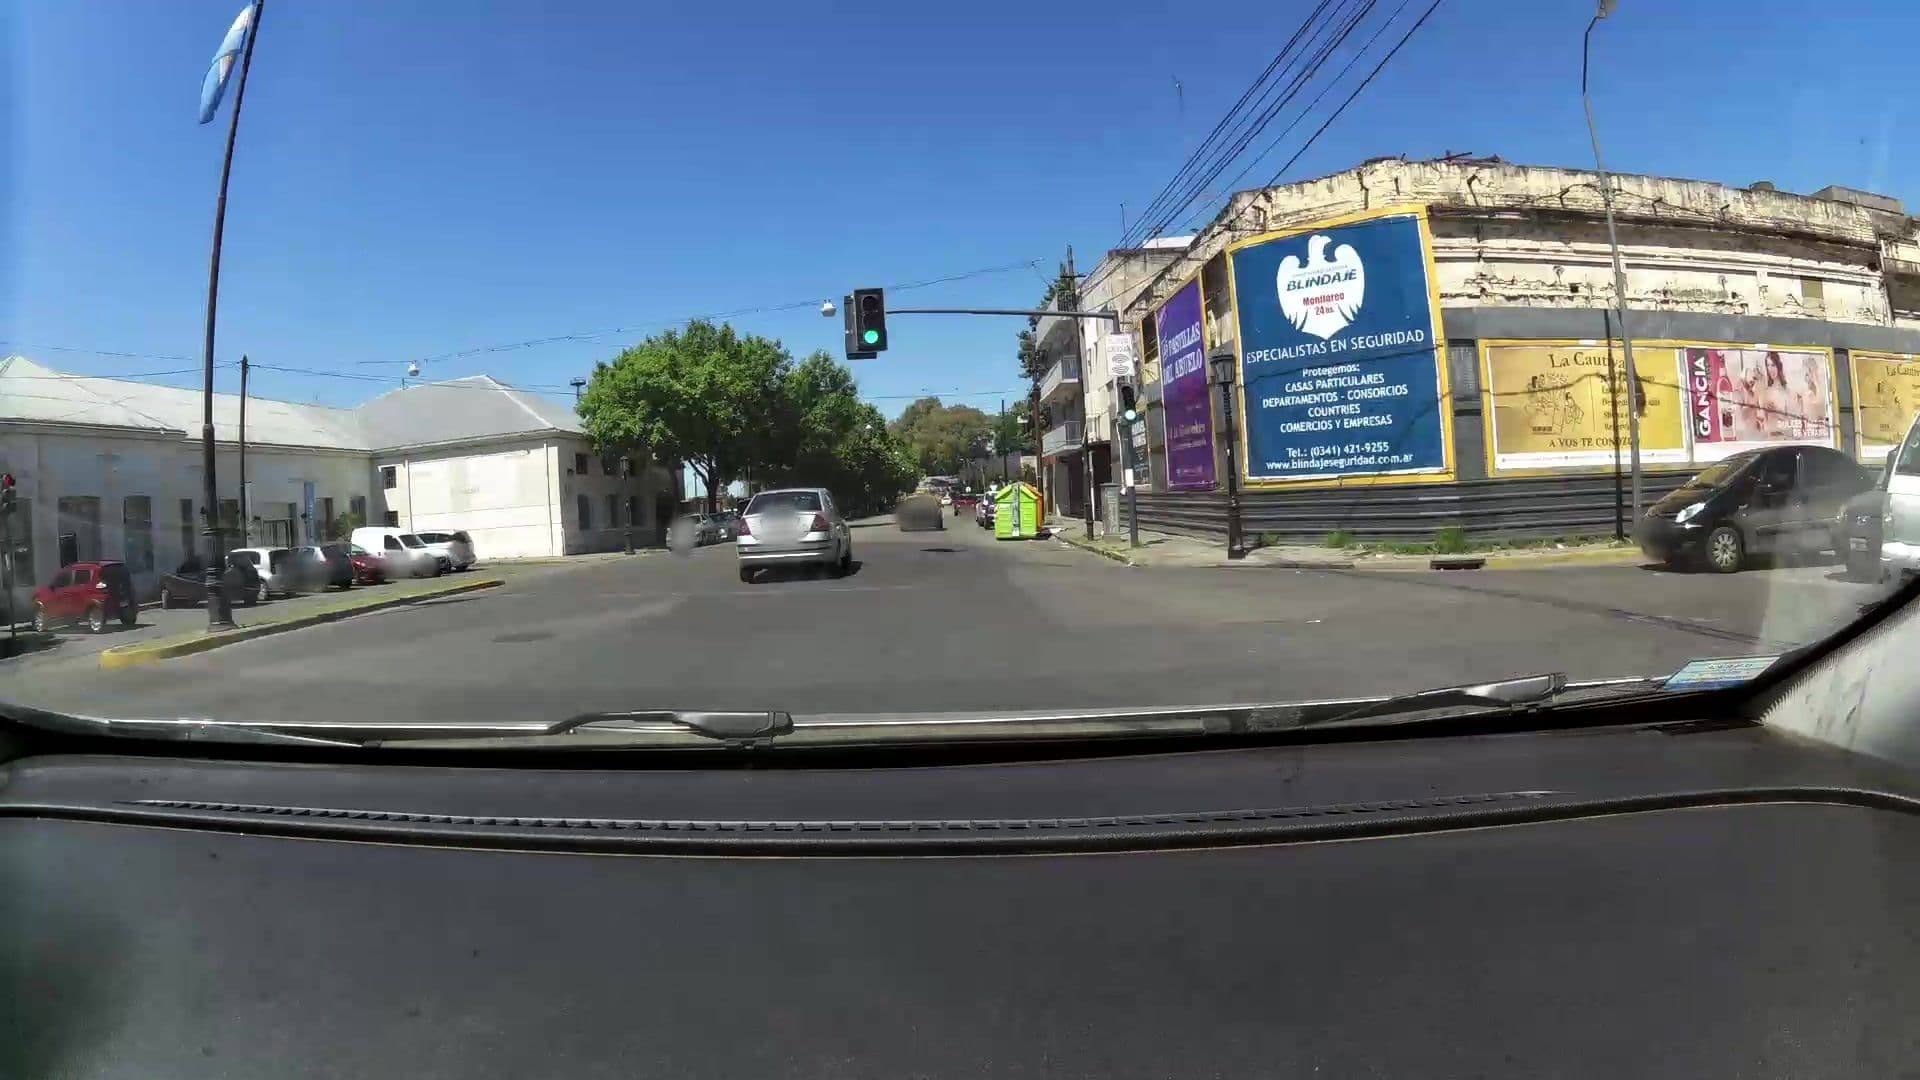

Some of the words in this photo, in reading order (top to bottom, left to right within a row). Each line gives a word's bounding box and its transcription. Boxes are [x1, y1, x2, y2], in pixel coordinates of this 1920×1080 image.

[1287, 269, 1357, 291] BLINDAJE
[1303, 292, 1344, 306] Monitoreo
[1169, 321, 1201, 357] PASTILLAS
[1247, 341, 1327, 364] ESPECIALISTAS
[1331, 339, 1347, 352] EN
[1351, 329, 1424, 351] SEGURIDAD
[1175, 348, 1203, 379] ABUELO
[1548, 354, 1570, 368] La
[1573, 351, 1625, 369] Cautva
[1302, 363, 1360, 378] Protegemos:
[1285, 380, 1314, 393] CASAS
[1315, 373, 1385, 391] PARTICULARES
[1262, 392, 1338, 408] DEPARTAMENTOS
[1347, 384, 1408, 400] CONSORCIOS
[1694, 356, 1711, 436] GANCIA
[1308, 404, 1361, 417] COUNTRIES
[1280, 419, 1333, 433] COMERCIOS
[1335, 419, 1341, 429] Y
[1343, 414, 1393, 429] EMPRESAS
[1286, 447, 1308, 458] Tel.:
[1310, 445, 1340, 457] (0341)
[1343, 442, 1389, 453] 421-9255
[1549, 440, 1556, 448] A
[1559, 438, 1578, 448] VOS
[1581, 437, 1593, 447] TE
[1266, 453, 1413, 470] www.blindajeseguridad.com.ar
